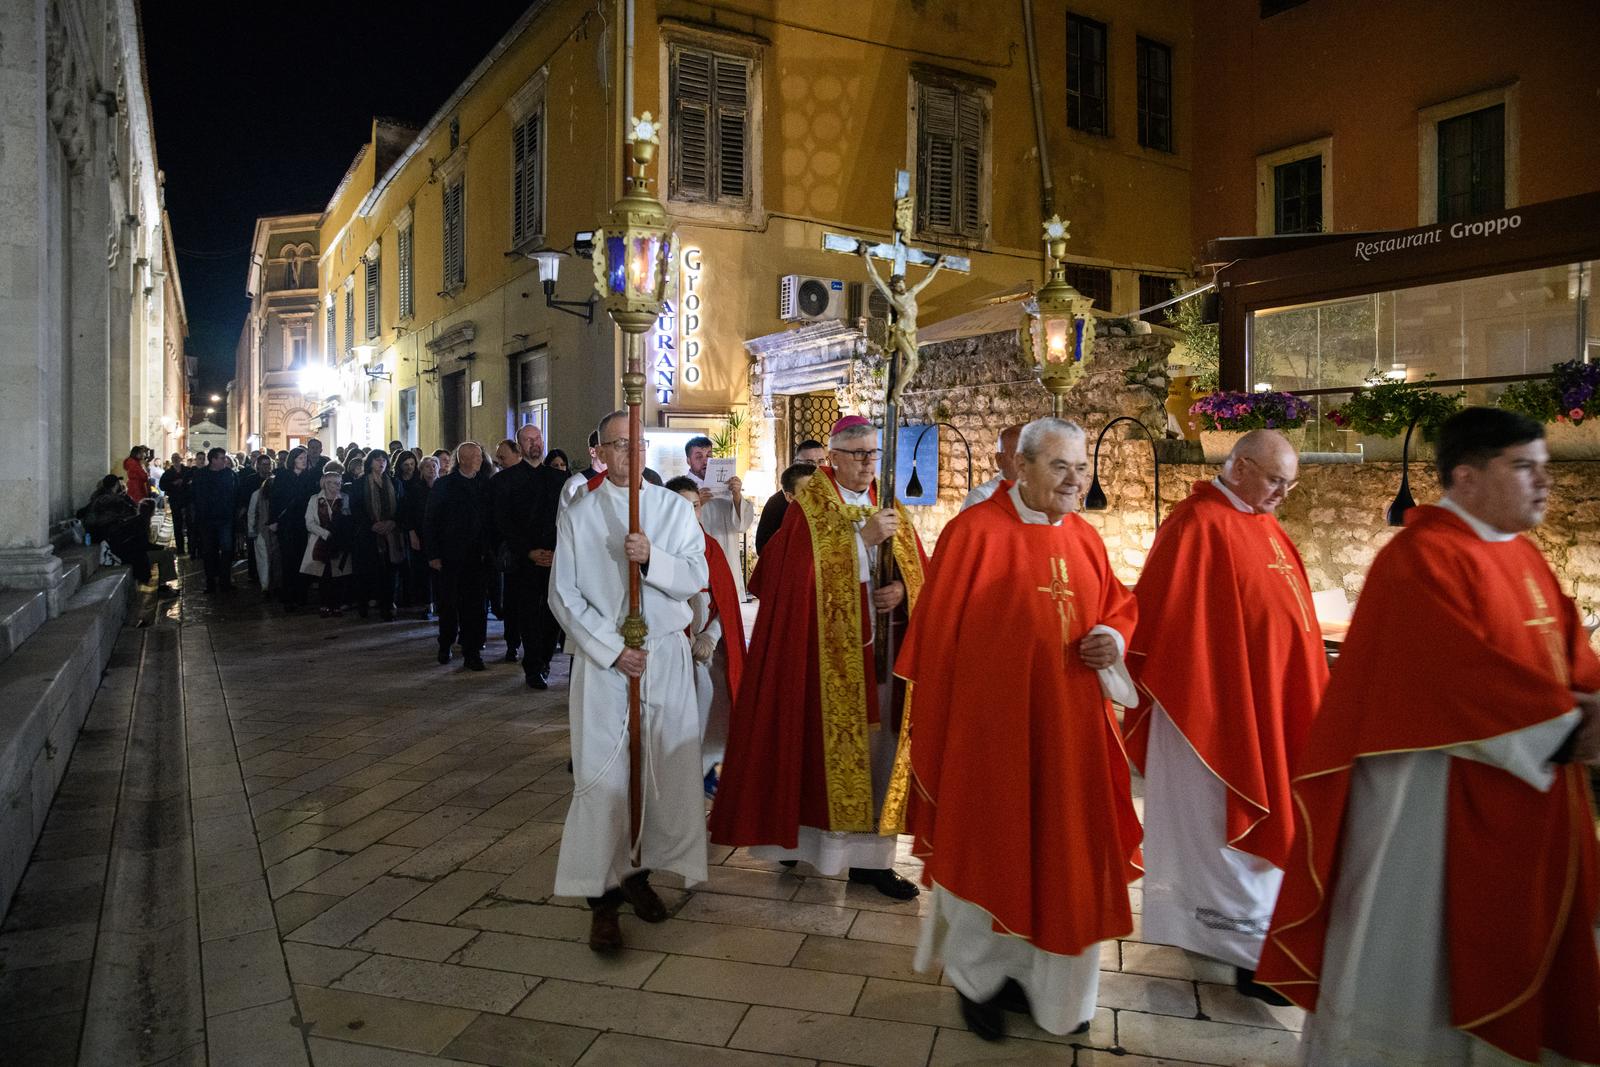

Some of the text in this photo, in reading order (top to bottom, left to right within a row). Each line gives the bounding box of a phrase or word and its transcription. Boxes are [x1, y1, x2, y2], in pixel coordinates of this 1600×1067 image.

[1355, 215, 1521, 261] Restaurant Groppo
[657, 253, 675, 405] AURANT
[684, 249, 701, 383] Groppo
